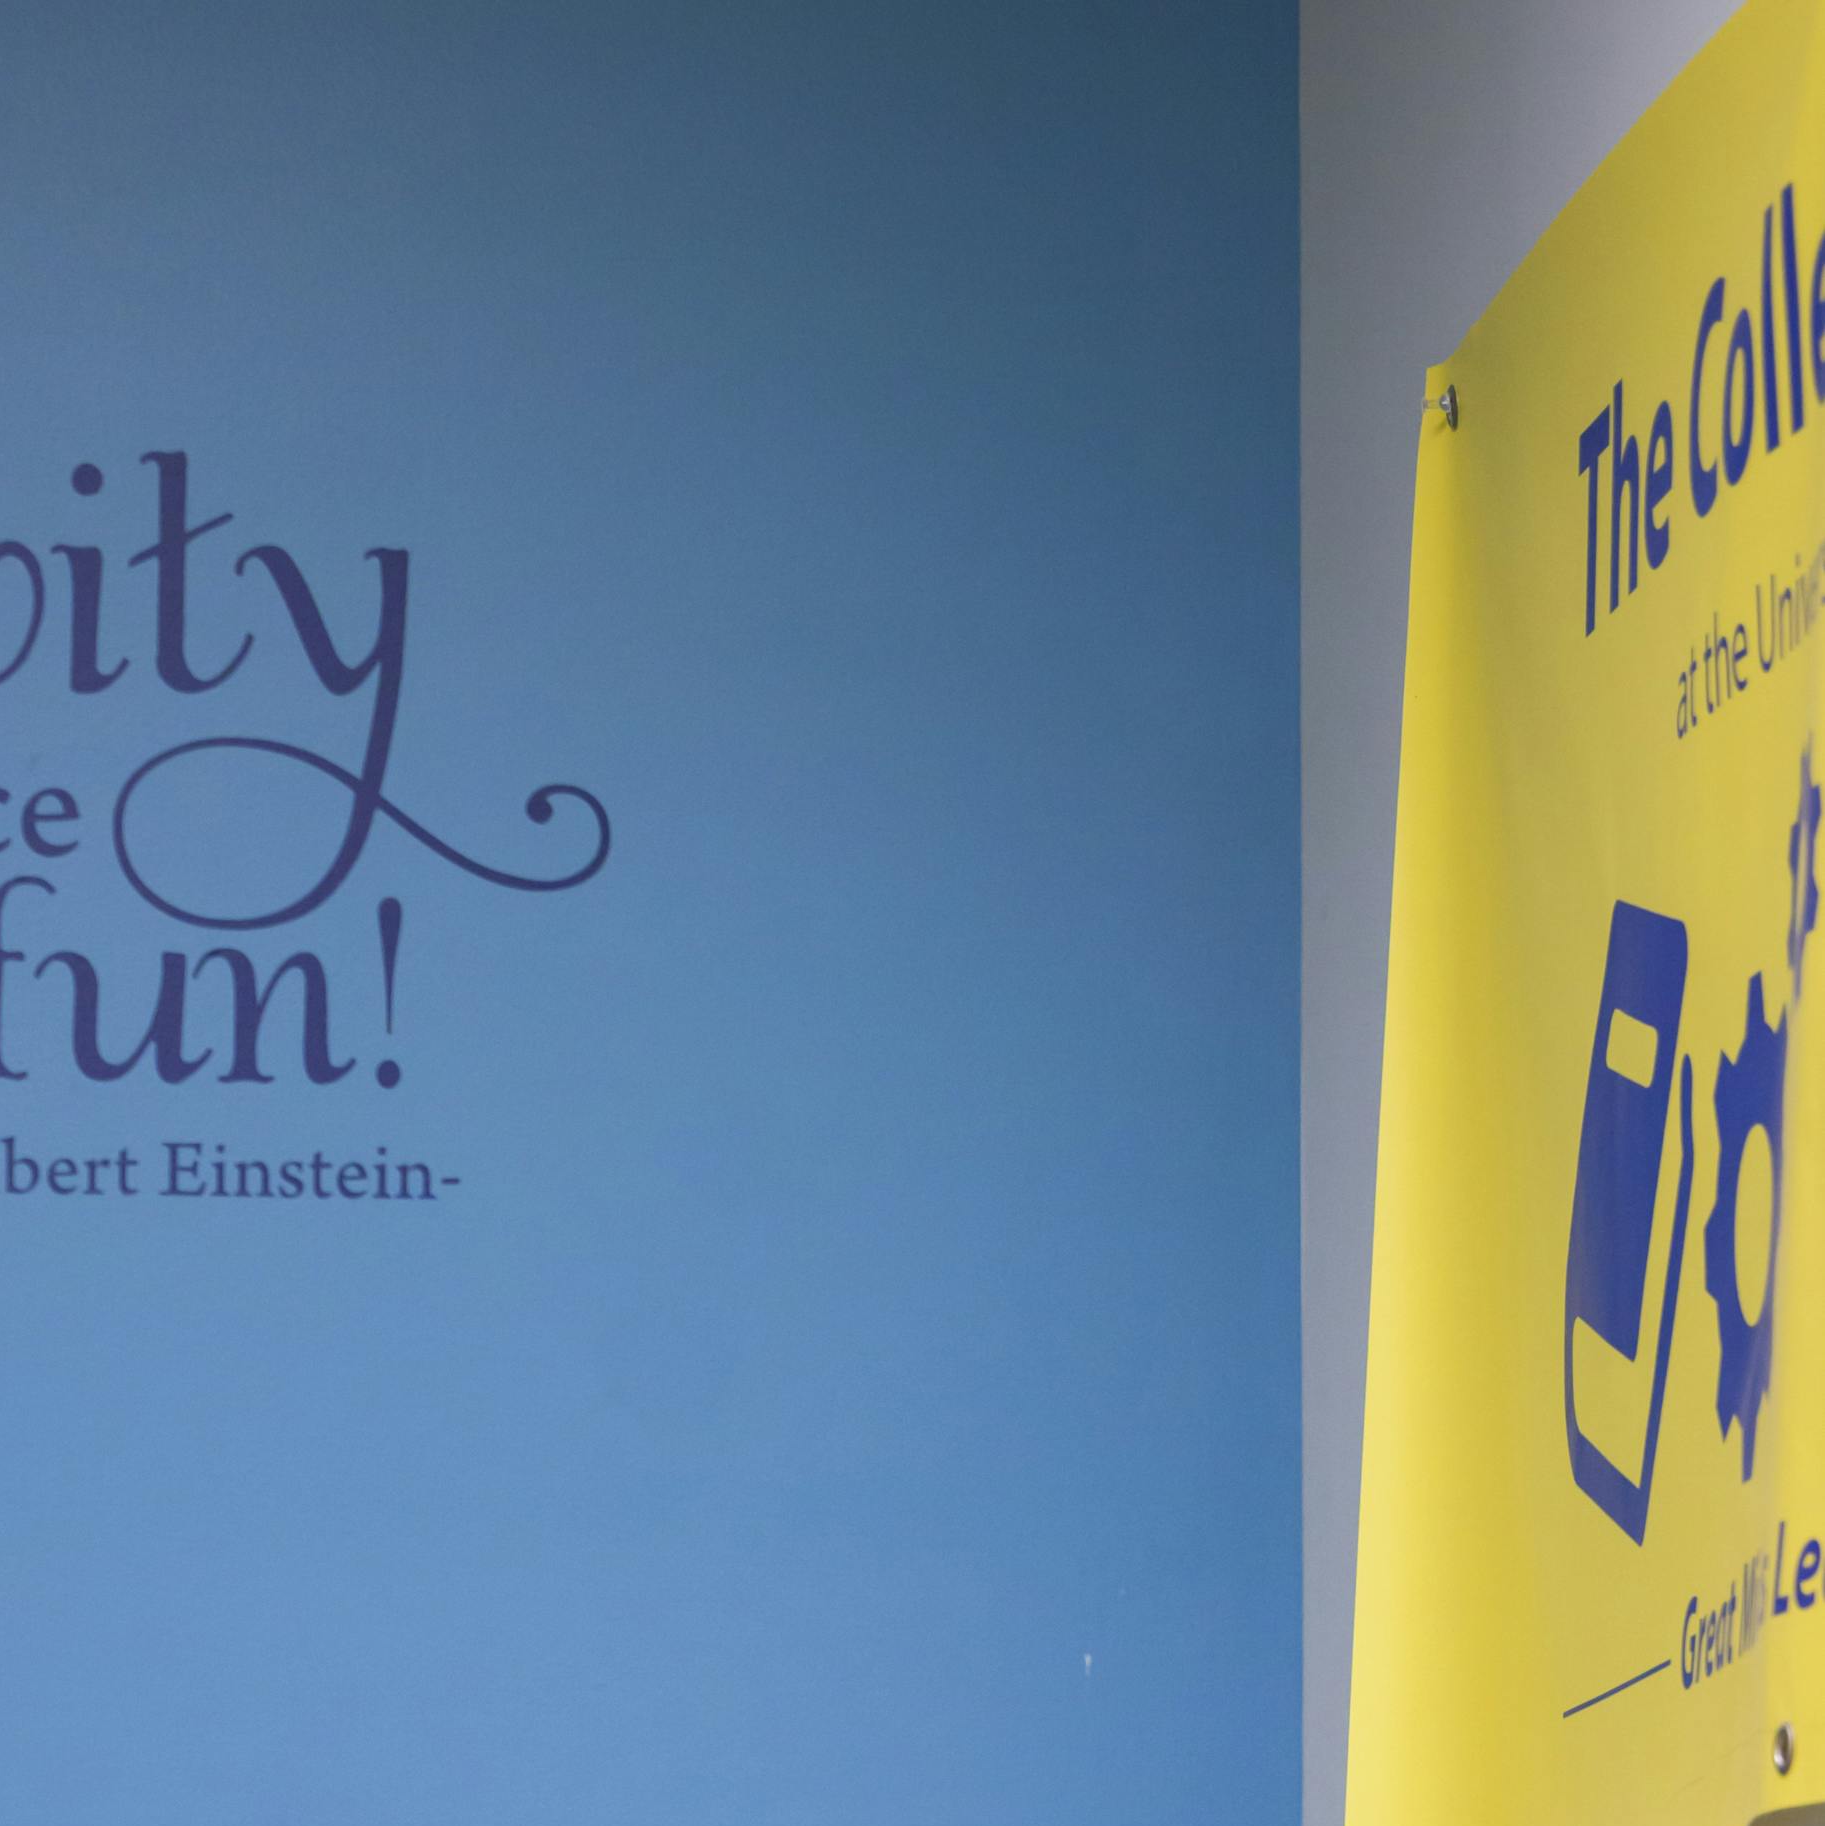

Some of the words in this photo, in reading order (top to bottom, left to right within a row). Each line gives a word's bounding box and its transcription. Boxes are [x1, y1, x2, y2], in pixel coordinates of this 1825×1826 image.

[1578, 378, 1674, 639] The
[1676, 646, 1698, 740] at
[1703, 611, 1749, 714] the
[160, 1141, 462, 1200] Einstein-
[1680, 1579, 1737, 1690] Great
[1772, 1519, 1825, 1617] Le
